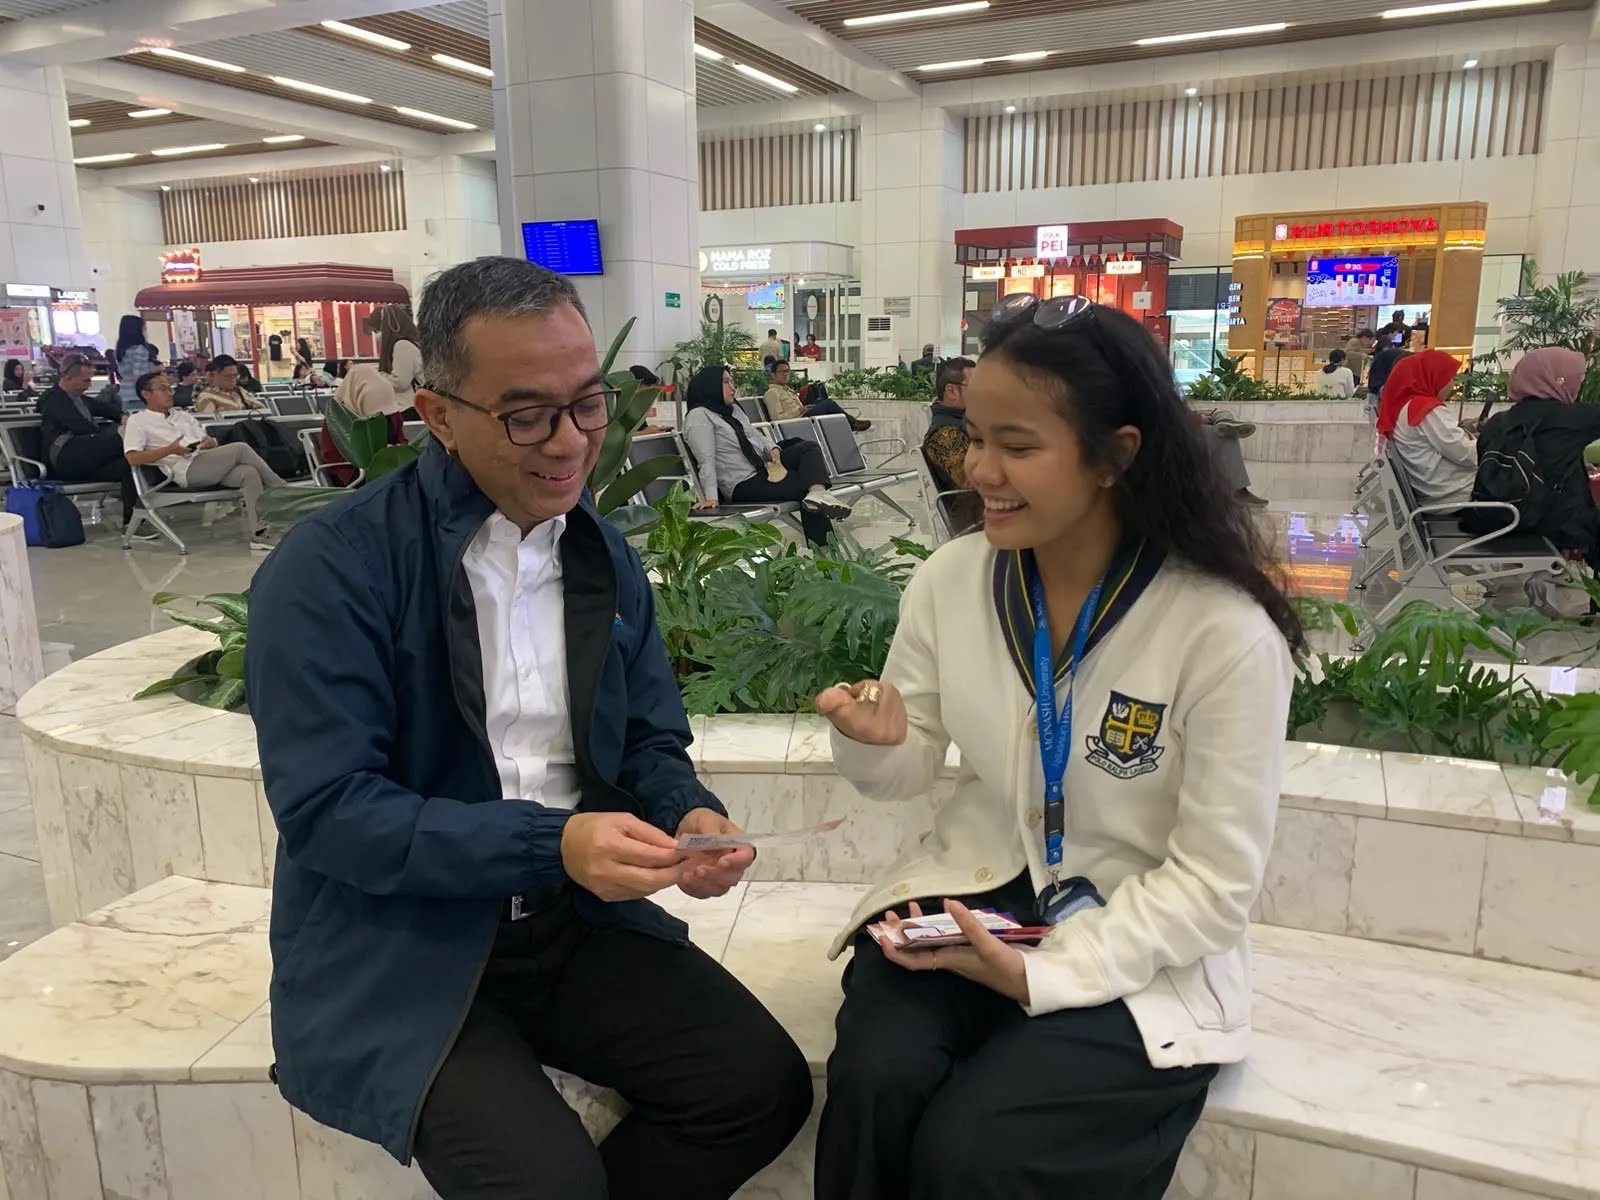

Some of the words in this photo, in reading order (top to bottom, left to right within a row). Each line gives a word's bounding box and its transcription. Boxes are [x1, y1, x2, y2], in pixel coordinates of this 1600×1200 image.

[1291, 216, 1438, 239] KURTOSHOYA
[710, 249, 745, 262] MAMA
[747, 248, 772, 260] ROZ
[1041, 240, 1063, 252] PEI
[713, 260, 739, 271] COLD
[740, 259, 770, 270] PRESS
[1040, 657, 1050, 702] University
[1040, 703, 1054, 751] MONASH
[1090, 755, 1108, 766] POLO
[1106, 762, 1129, 777] RALPH
